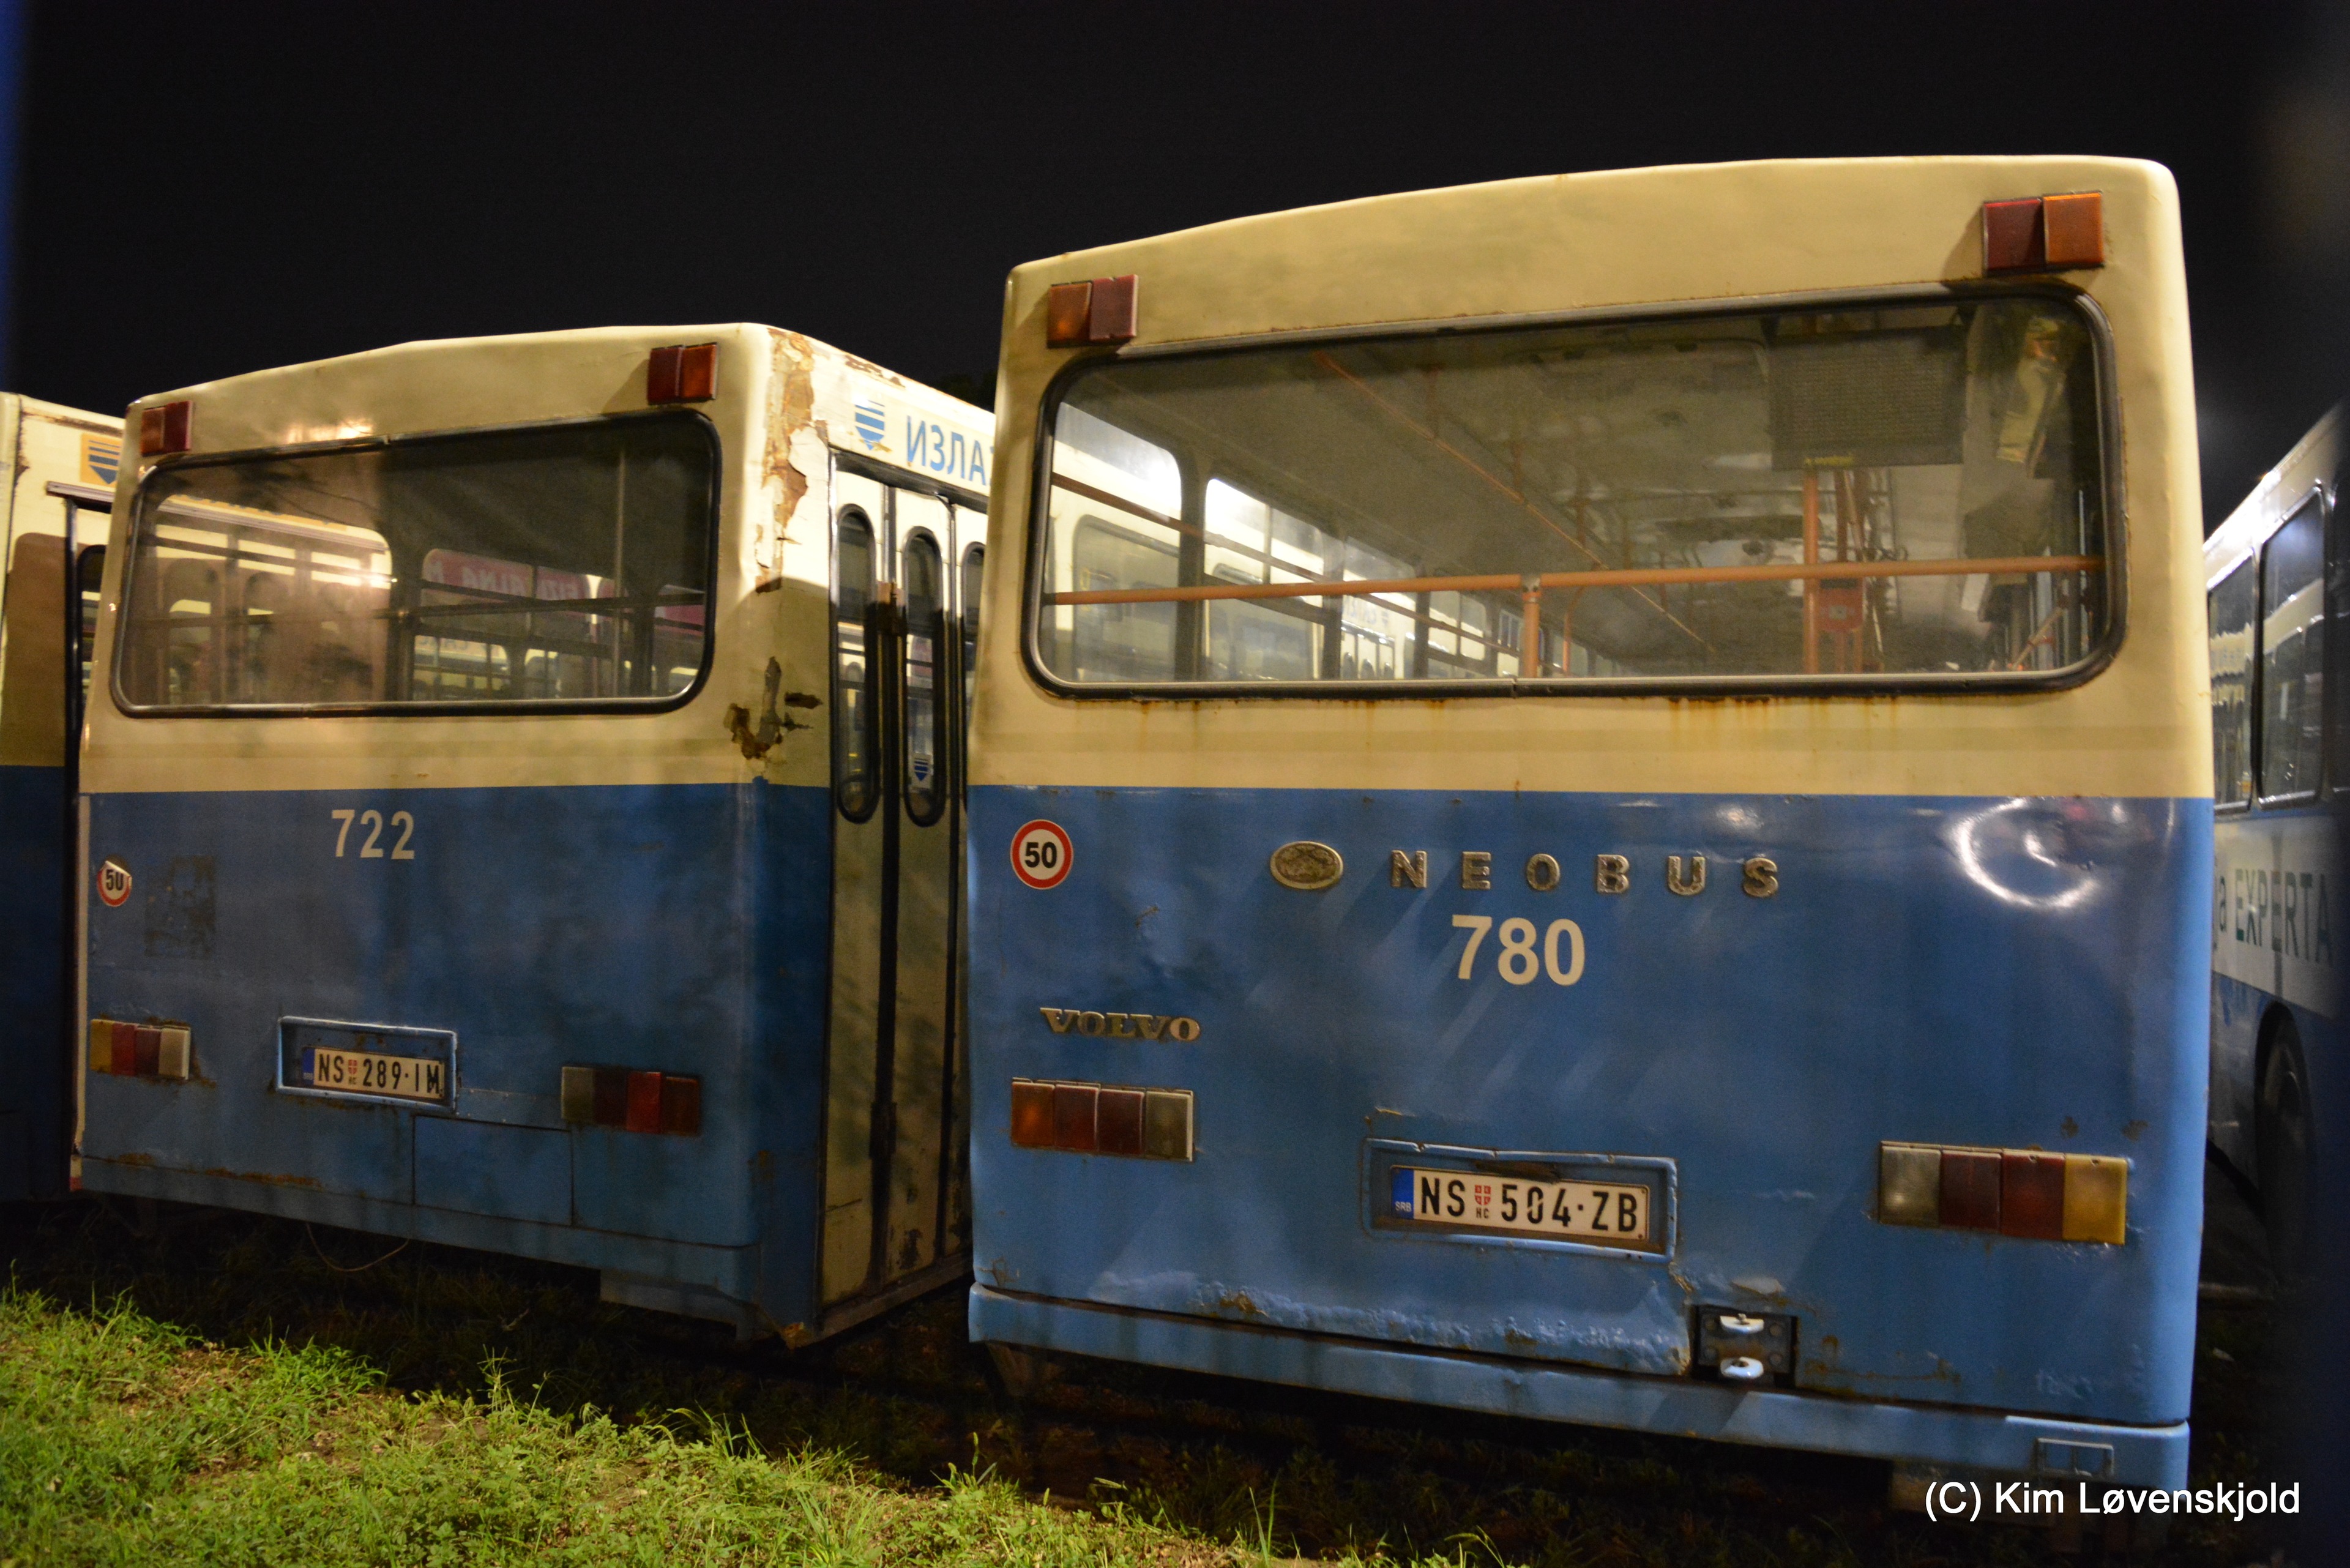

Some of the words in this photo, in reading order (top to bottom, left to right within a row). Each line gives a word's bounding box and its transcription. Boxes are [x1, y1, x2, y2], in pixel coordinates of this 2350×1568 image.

[907, 415, 995, 487] ИЗЛА
[332, 809, 416, 859] 722
[1024, 842, 1058, 868] 50
[1391, 850, 1779, 898] NEOBUS
[2236, 869, 2333, 965] EXPERTA
[1452, 915, 1585, 985] 780
[1040, 1007, 1201, 1042] VOLVO
[318, 1053, 345, 1083] NS
[1395, 1201, 1412, 1212] SRB
[1421, 1176, 1466, 1217] NS
